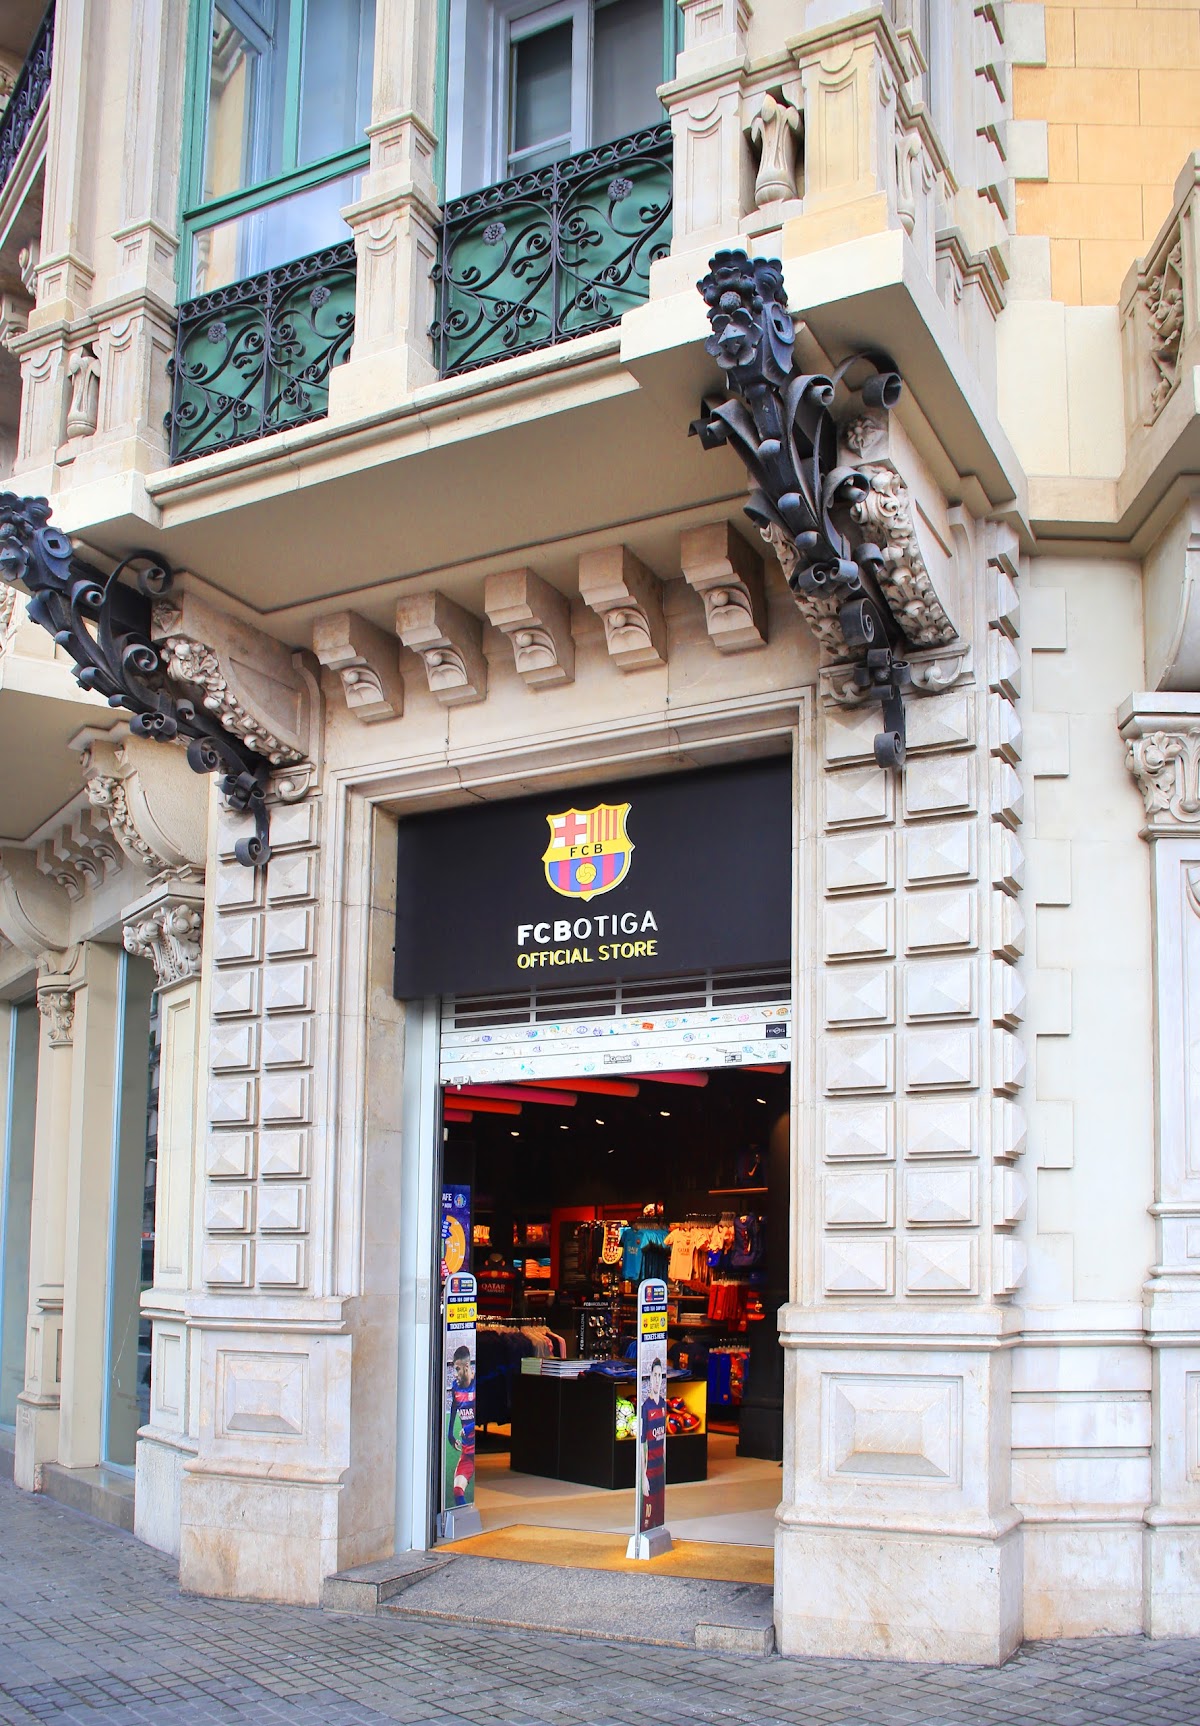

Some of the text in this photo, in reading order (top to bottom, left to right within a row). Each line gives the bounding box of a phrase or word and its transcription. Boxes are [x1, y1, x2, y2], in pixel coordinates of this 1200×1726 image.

[570, 843, 603, 857] FCB
[517, 910, 658, 946] FCBOTIGA
[517, 939, 658, 969] OFFICIAL STORE
[643, 1333, 656, 1341] TICKETS
